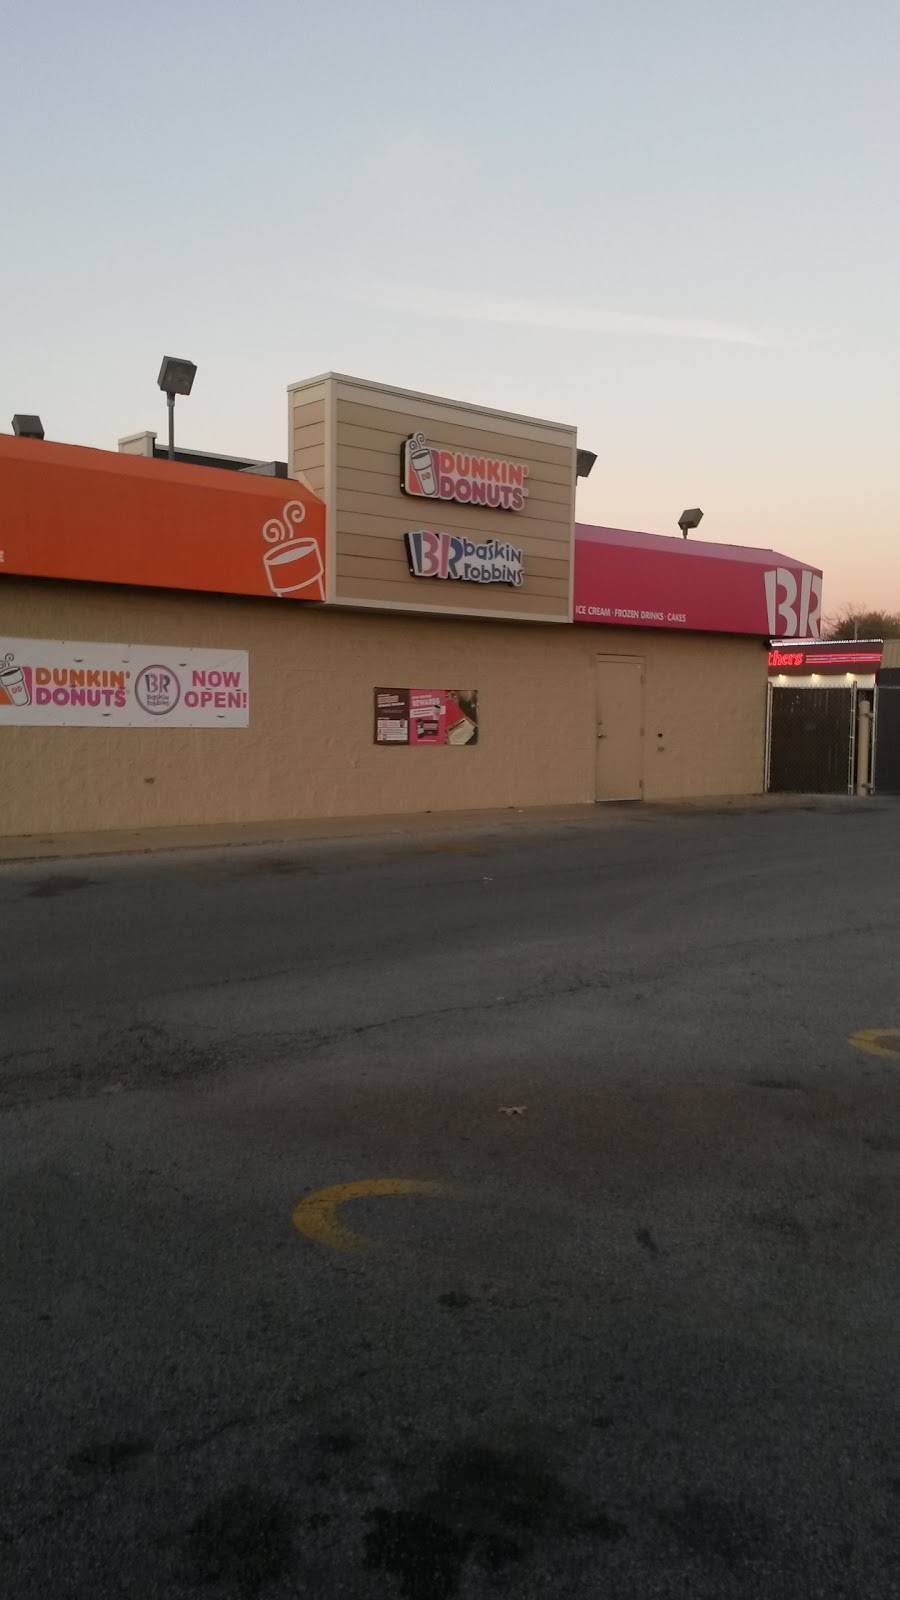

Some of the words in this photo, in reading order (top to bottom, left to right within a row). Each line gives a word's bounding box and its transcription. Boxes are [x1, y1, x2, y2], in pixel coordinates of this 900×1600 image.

[439, 451, 528, 485] DUNKIN'
[440, 476, 524, 511] DONUTS
[412, 531, 464, 577] BR
[764, 567, 822, 638] BR
[576, 605, 586, 615] ICE
[588, 606, 611, 617] CREAM
[614, 609, 639, 619] FROZEN
[641, 611, 664, 621] DRINKS
[667, 612, 687, 623] CAKES
[35, 667, 130, 689] DUNKIN'
[145, 673, 170, 693] BR
[192, 671, 240, 687] NOW
[36, 687, 126, 707] DONUTS
[184, 691, 247, 708] OPEN!
